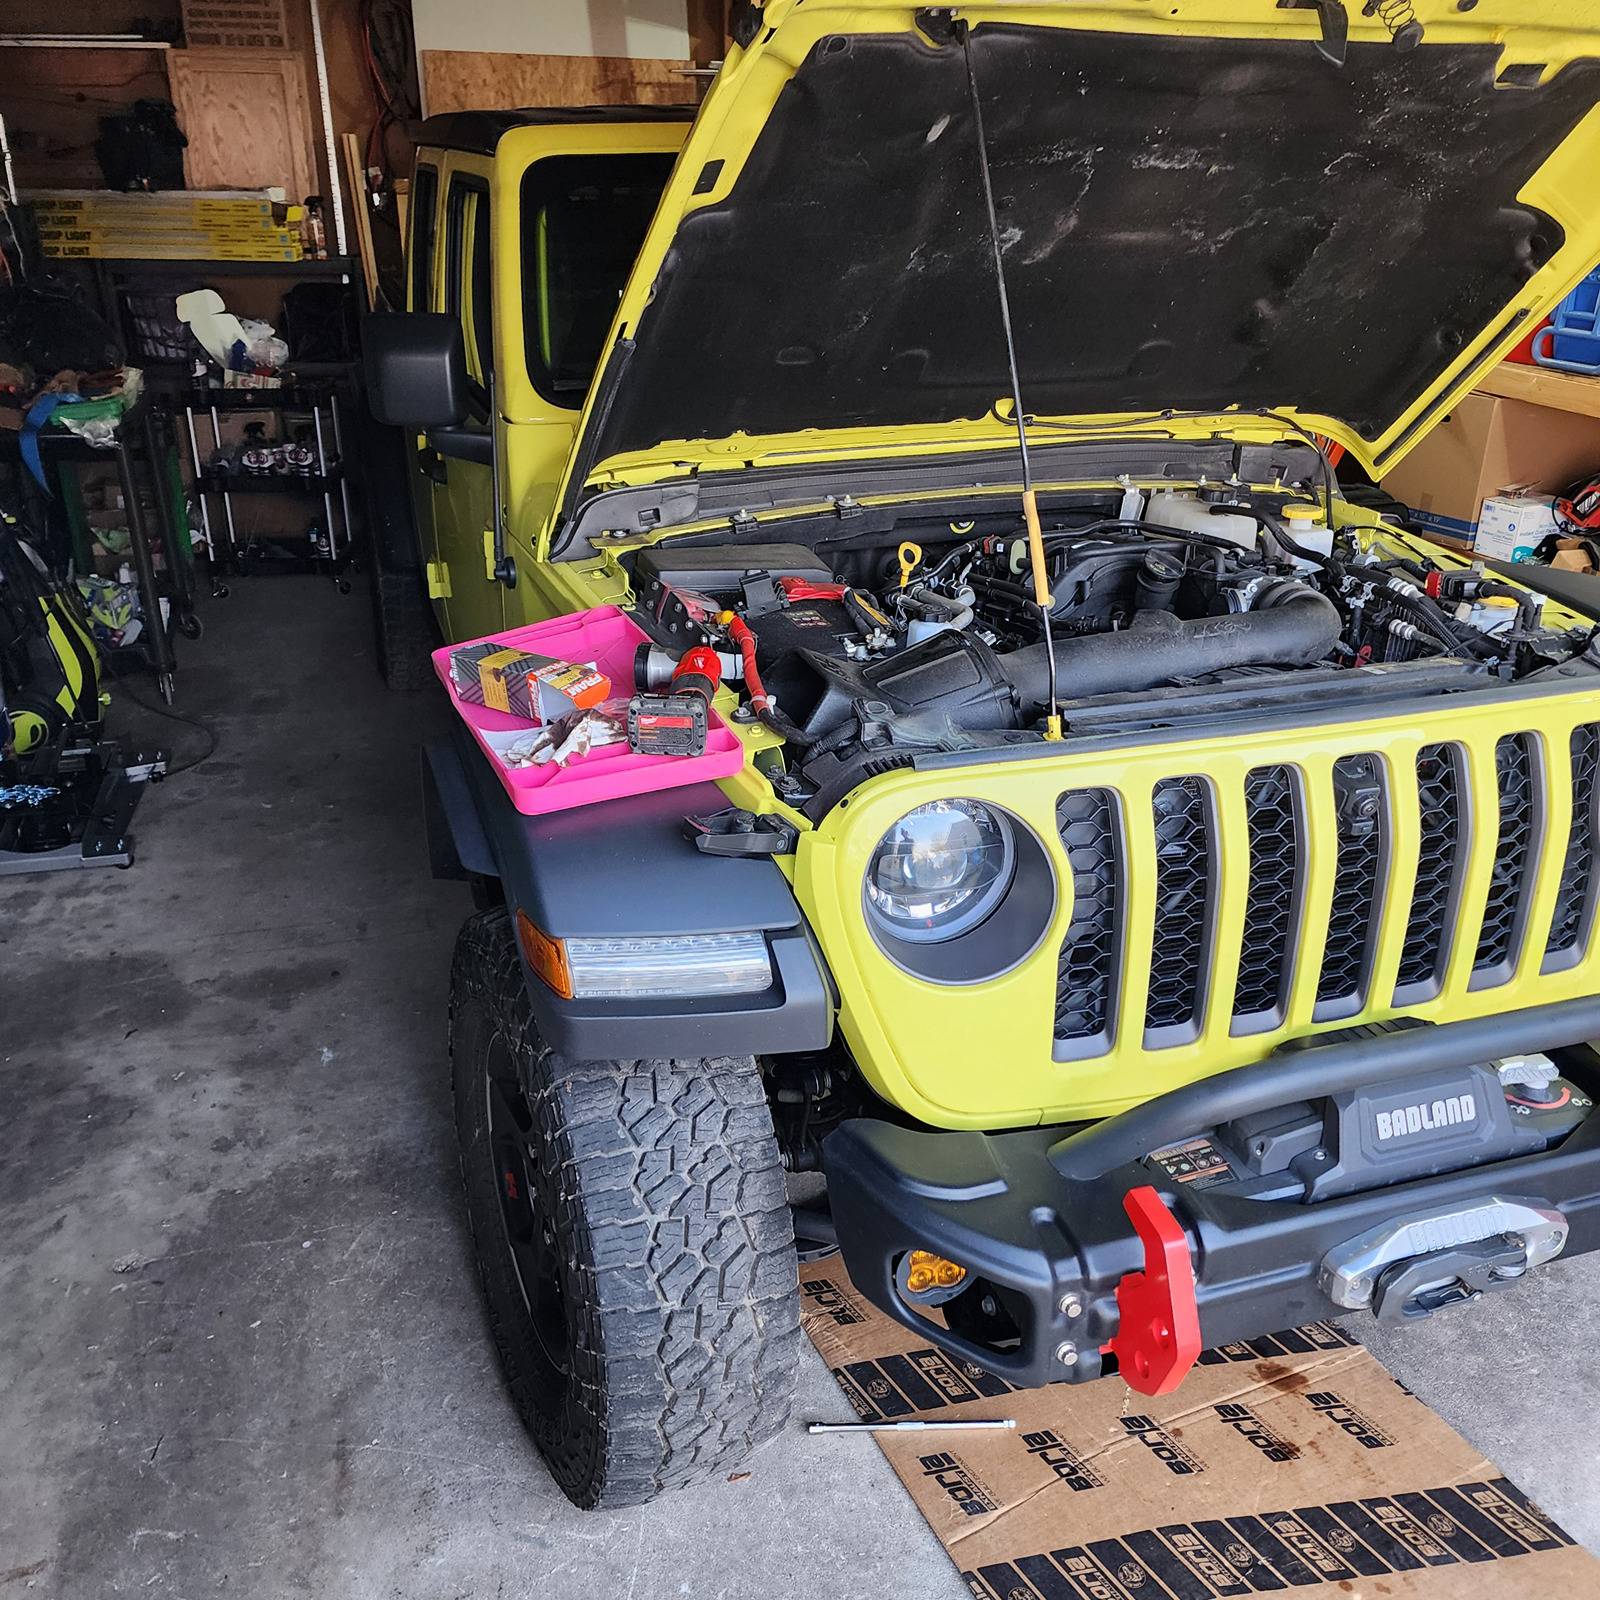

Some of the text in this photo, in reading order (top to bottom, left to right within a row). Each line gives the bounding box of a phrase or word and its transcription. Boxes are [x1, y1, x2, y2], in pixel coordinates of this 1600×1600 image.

[566, 673, 604, 697] FRAM
[1375, 1094, 1477, 1141] BADLAND
[954, 1470, 999, 1512] EXHAUST
